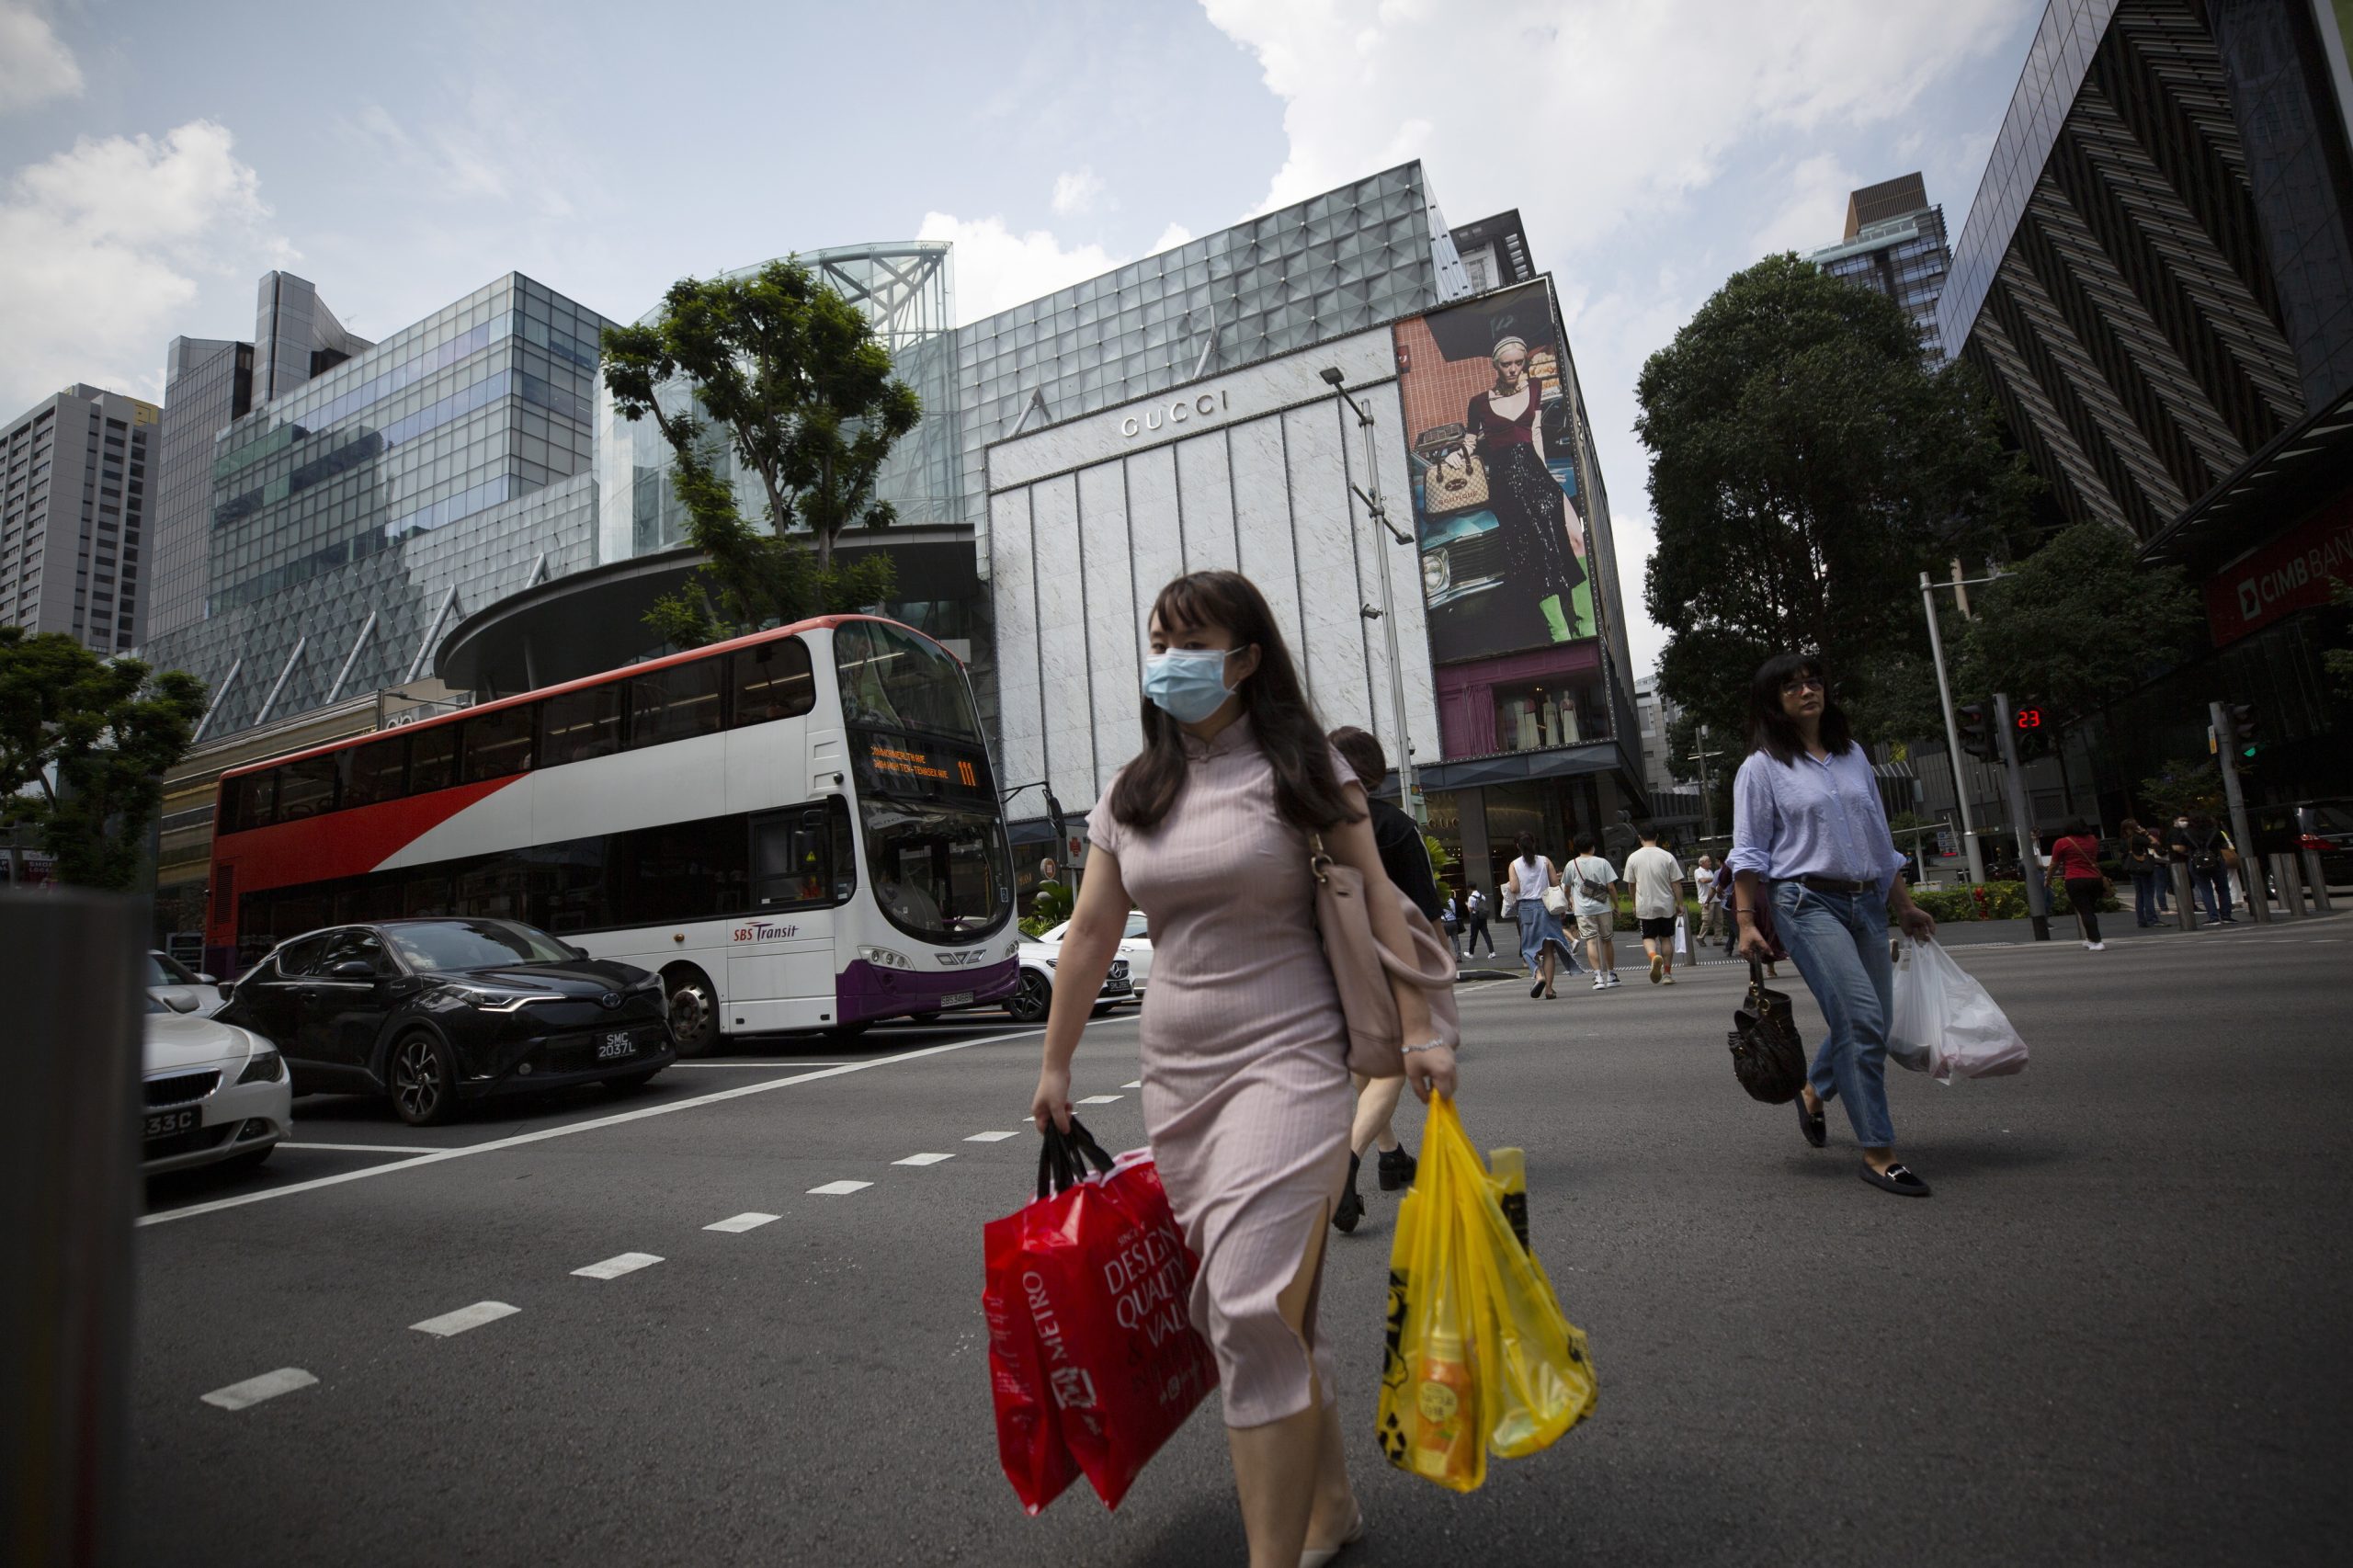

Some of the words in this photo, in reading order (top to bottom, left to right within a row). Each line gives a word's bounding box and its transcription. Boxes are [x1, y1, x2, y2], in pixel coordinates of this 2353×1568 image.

[1121, 390, 1228, 437] GUCCI
[2261, 557, 2309, 603] CIMB
[2308, 530, 2353, 578] BAN
[2018, 710, 2040, 728] 23
[958, 761, 976, 787] 111
[734, 928, 753, 941] SBS
[752, 923, 800, 942] Transit
[598, 1042, 636, 1057] 2037L
[607, 1032, 629, 1045] SMC
[1104, 1217, 1184, 1296] DESIGN
[1022, 1271, 1069, 1361] METRO
[1146, 1283, 1192, 1348] VALU
